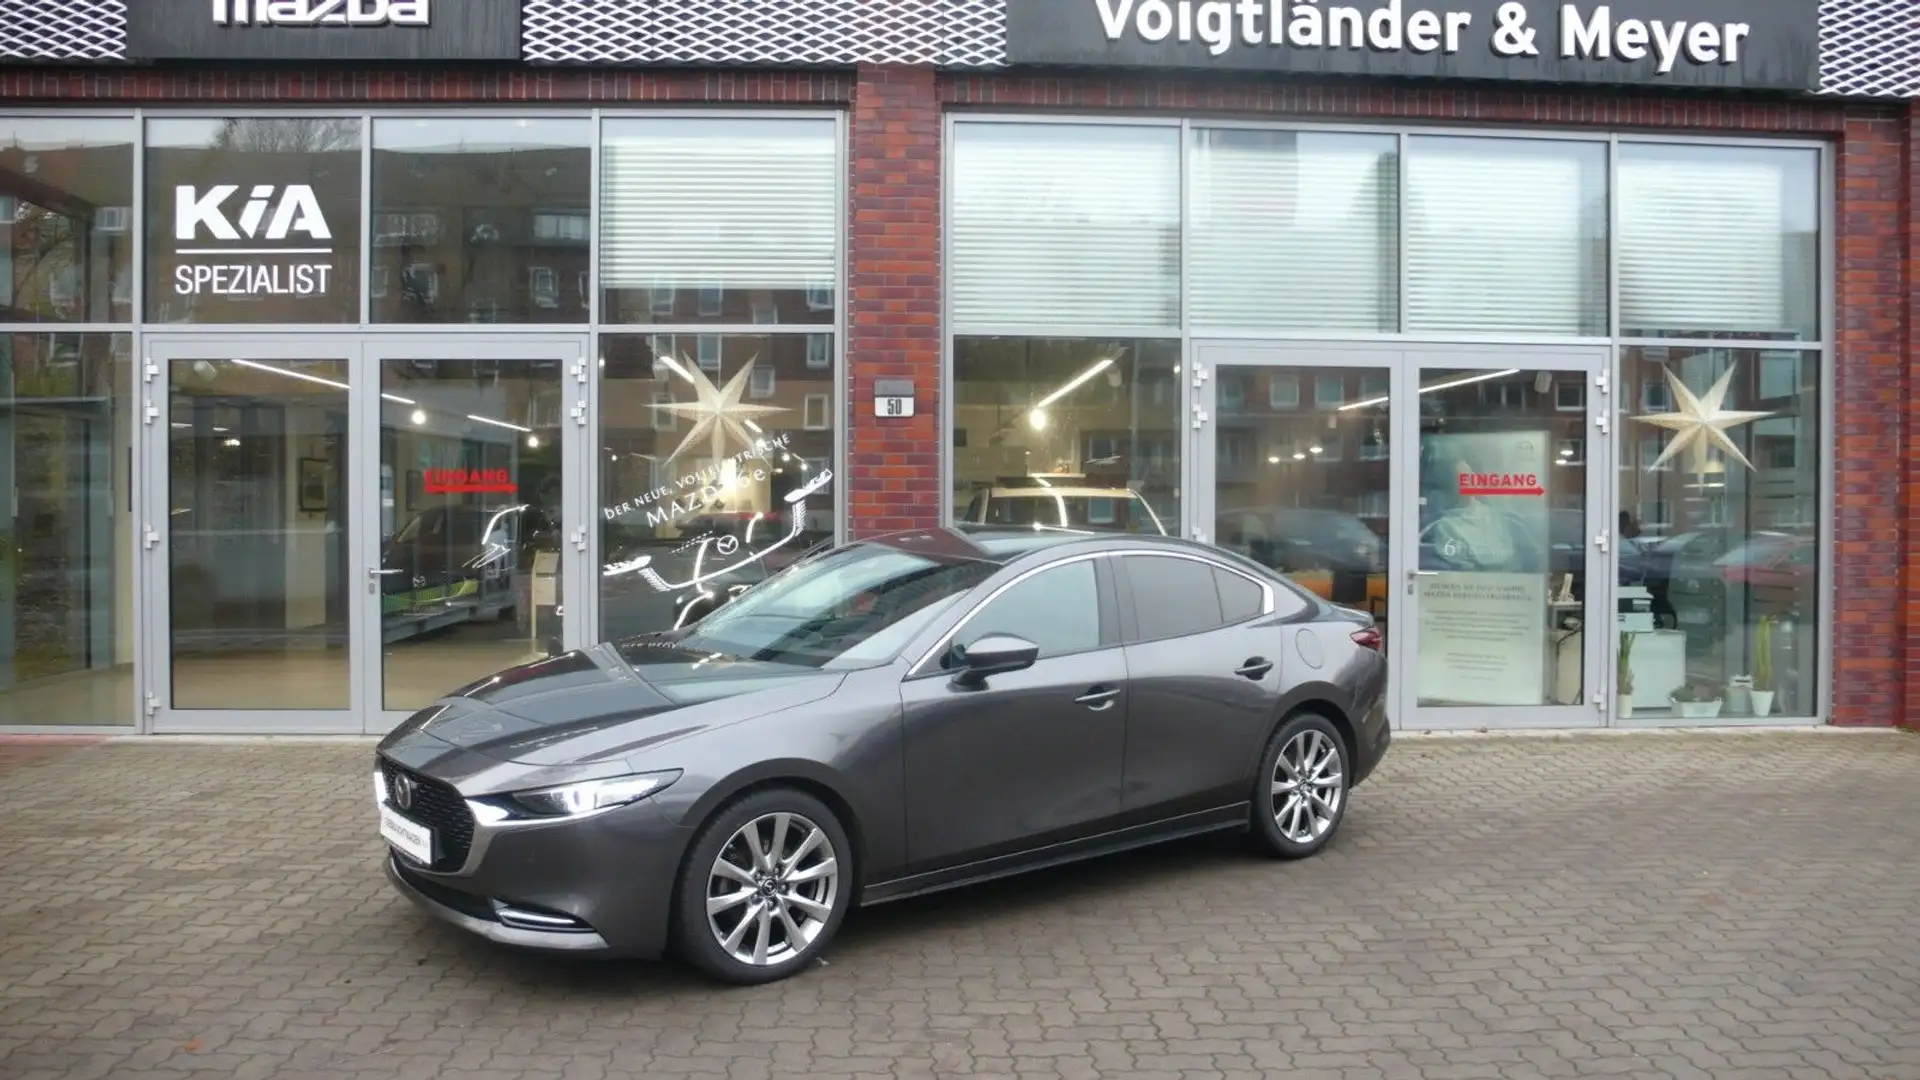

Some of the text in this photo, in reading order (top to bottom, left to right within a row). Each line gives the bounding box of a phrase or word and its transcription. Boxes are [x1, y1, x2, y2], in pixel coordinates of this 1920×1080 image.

[1094, 0, 1749, 73] Voigtländer & Meyer
[175, 265, 332, 294] SPEZIALIST
[887, 399, 902, 415] 50
[1460, 473, 1537, 486] EINGANG
[604, 501, 634, 520] DER
